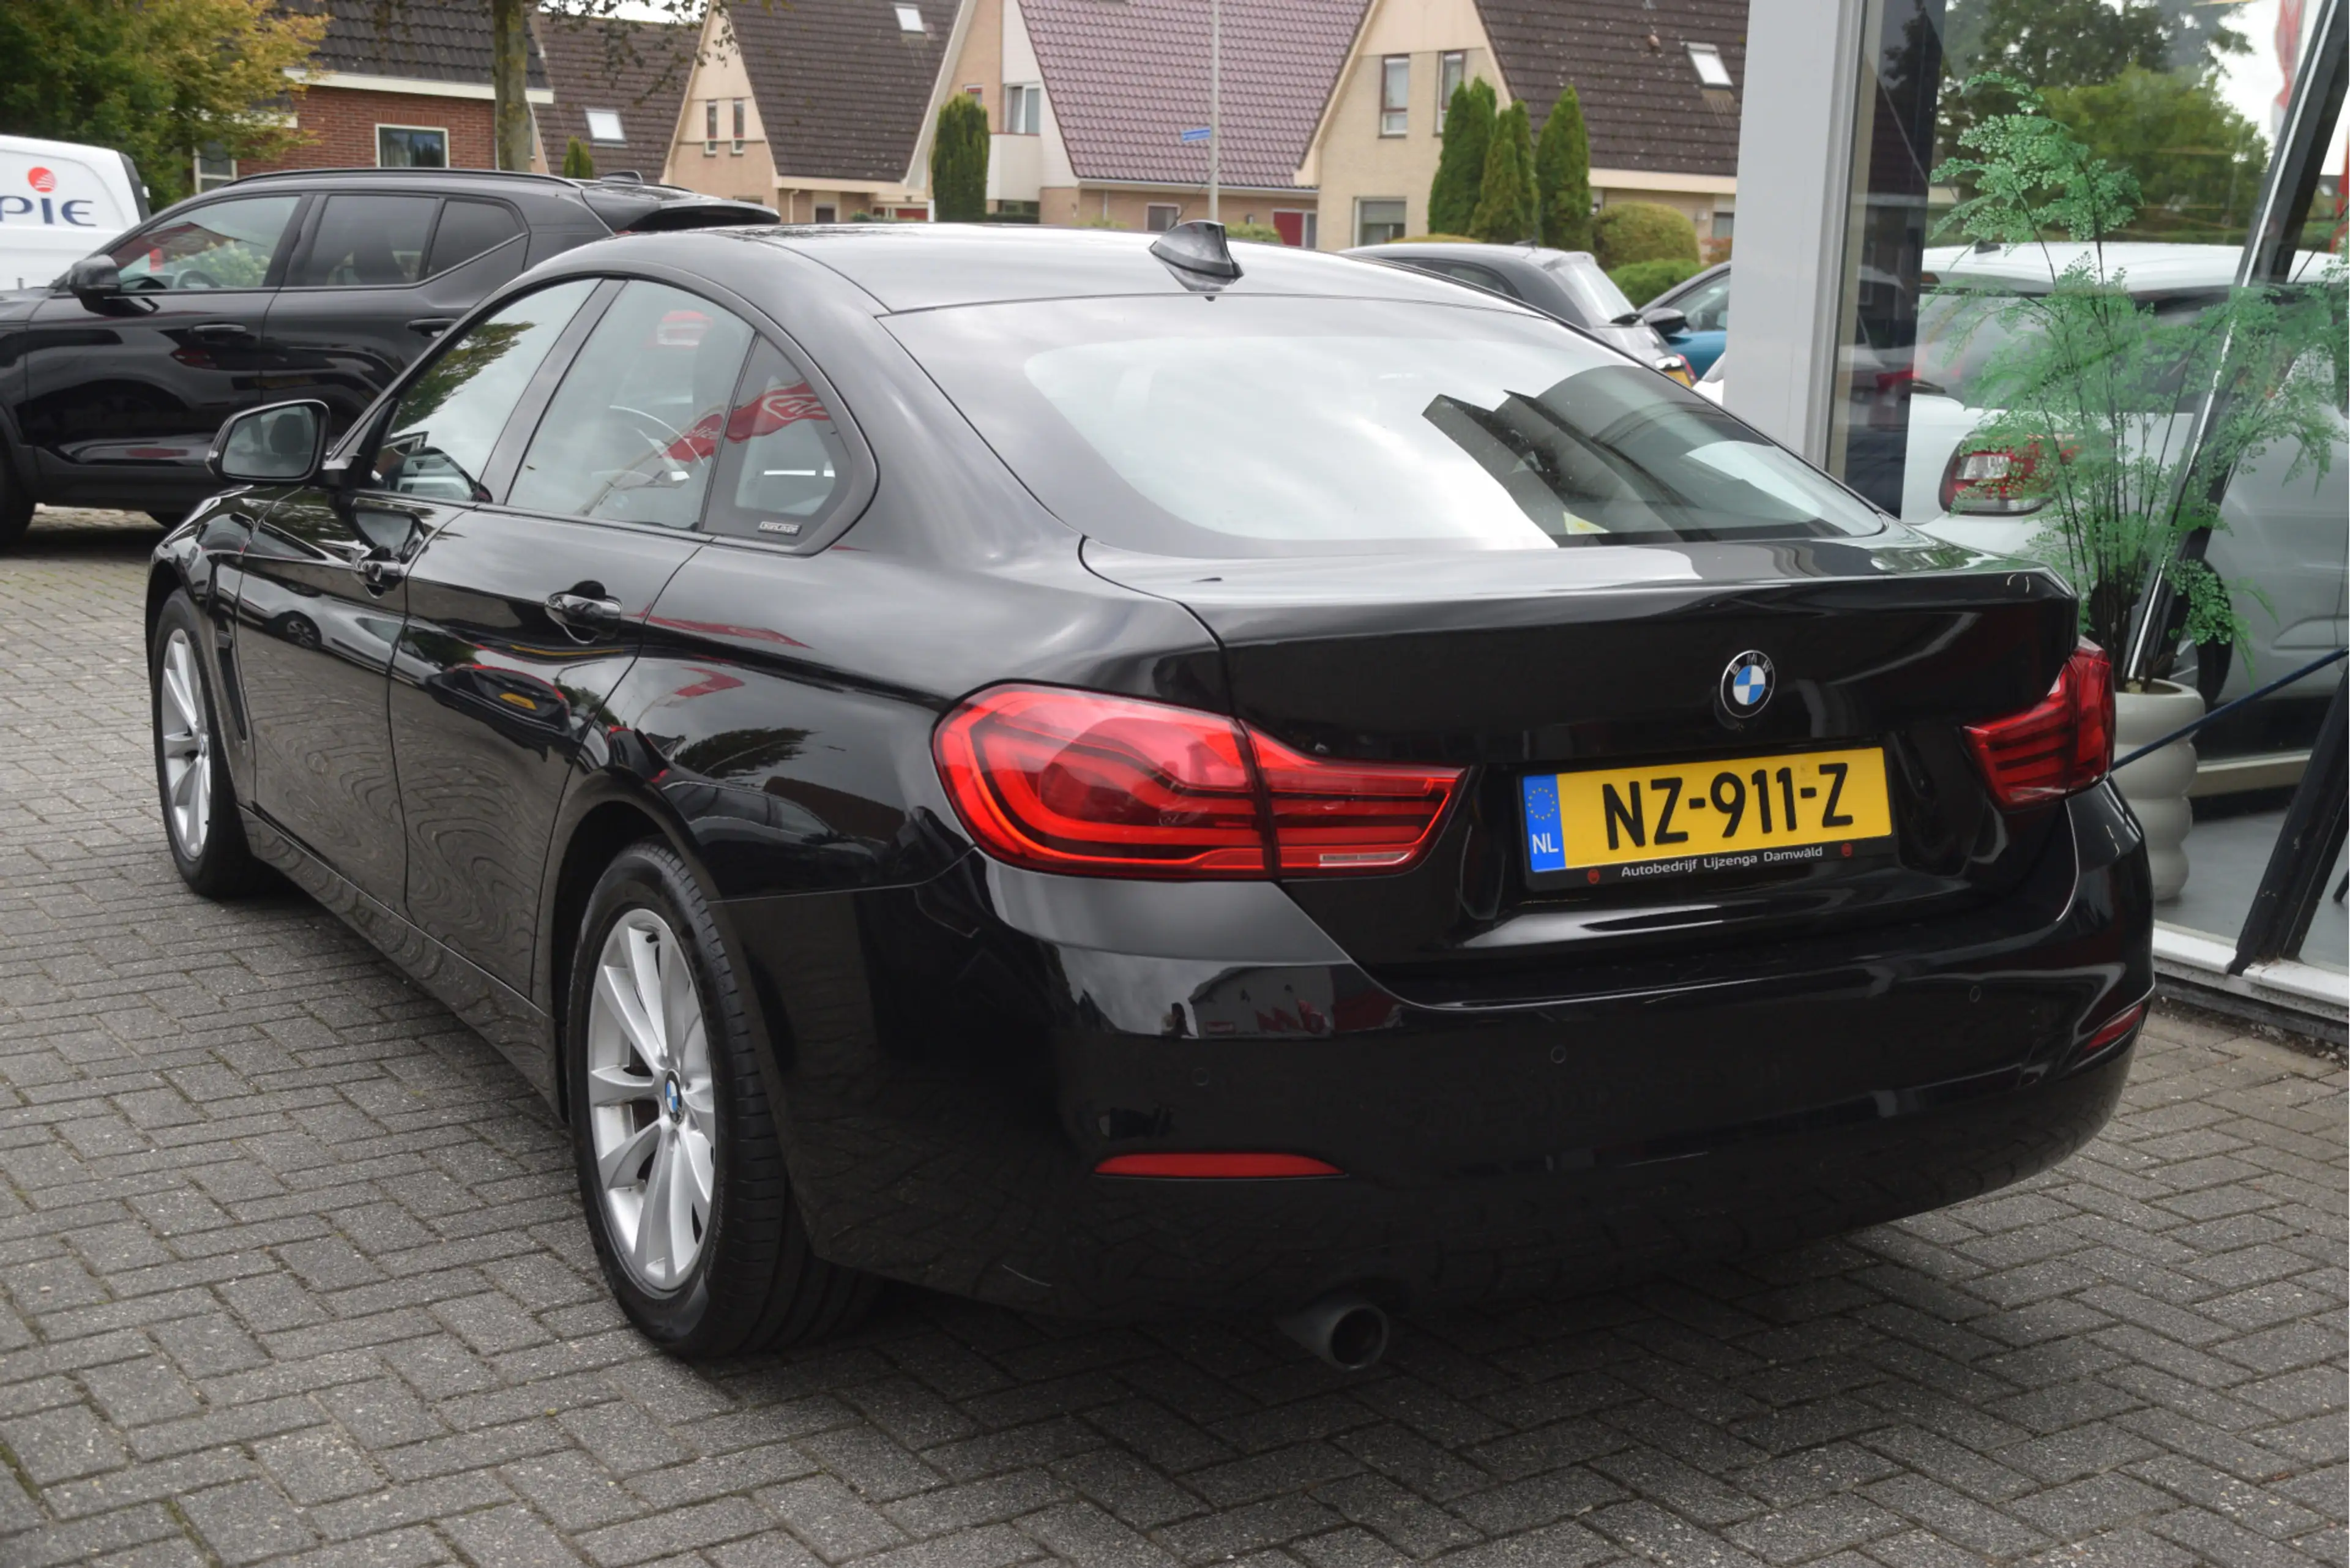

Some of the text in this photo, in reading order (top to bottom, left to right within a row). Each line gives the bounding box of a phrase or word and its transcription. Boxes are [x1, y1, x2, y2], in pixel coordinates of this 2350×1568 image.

[1602, 763, 1853, 850] NZ-911-Z
[1532, 832, 1559, 854] NL
[1621, 859, 1698, 878] Autobedrijf
[1703, 854, 1758, 870] Lijzenga
